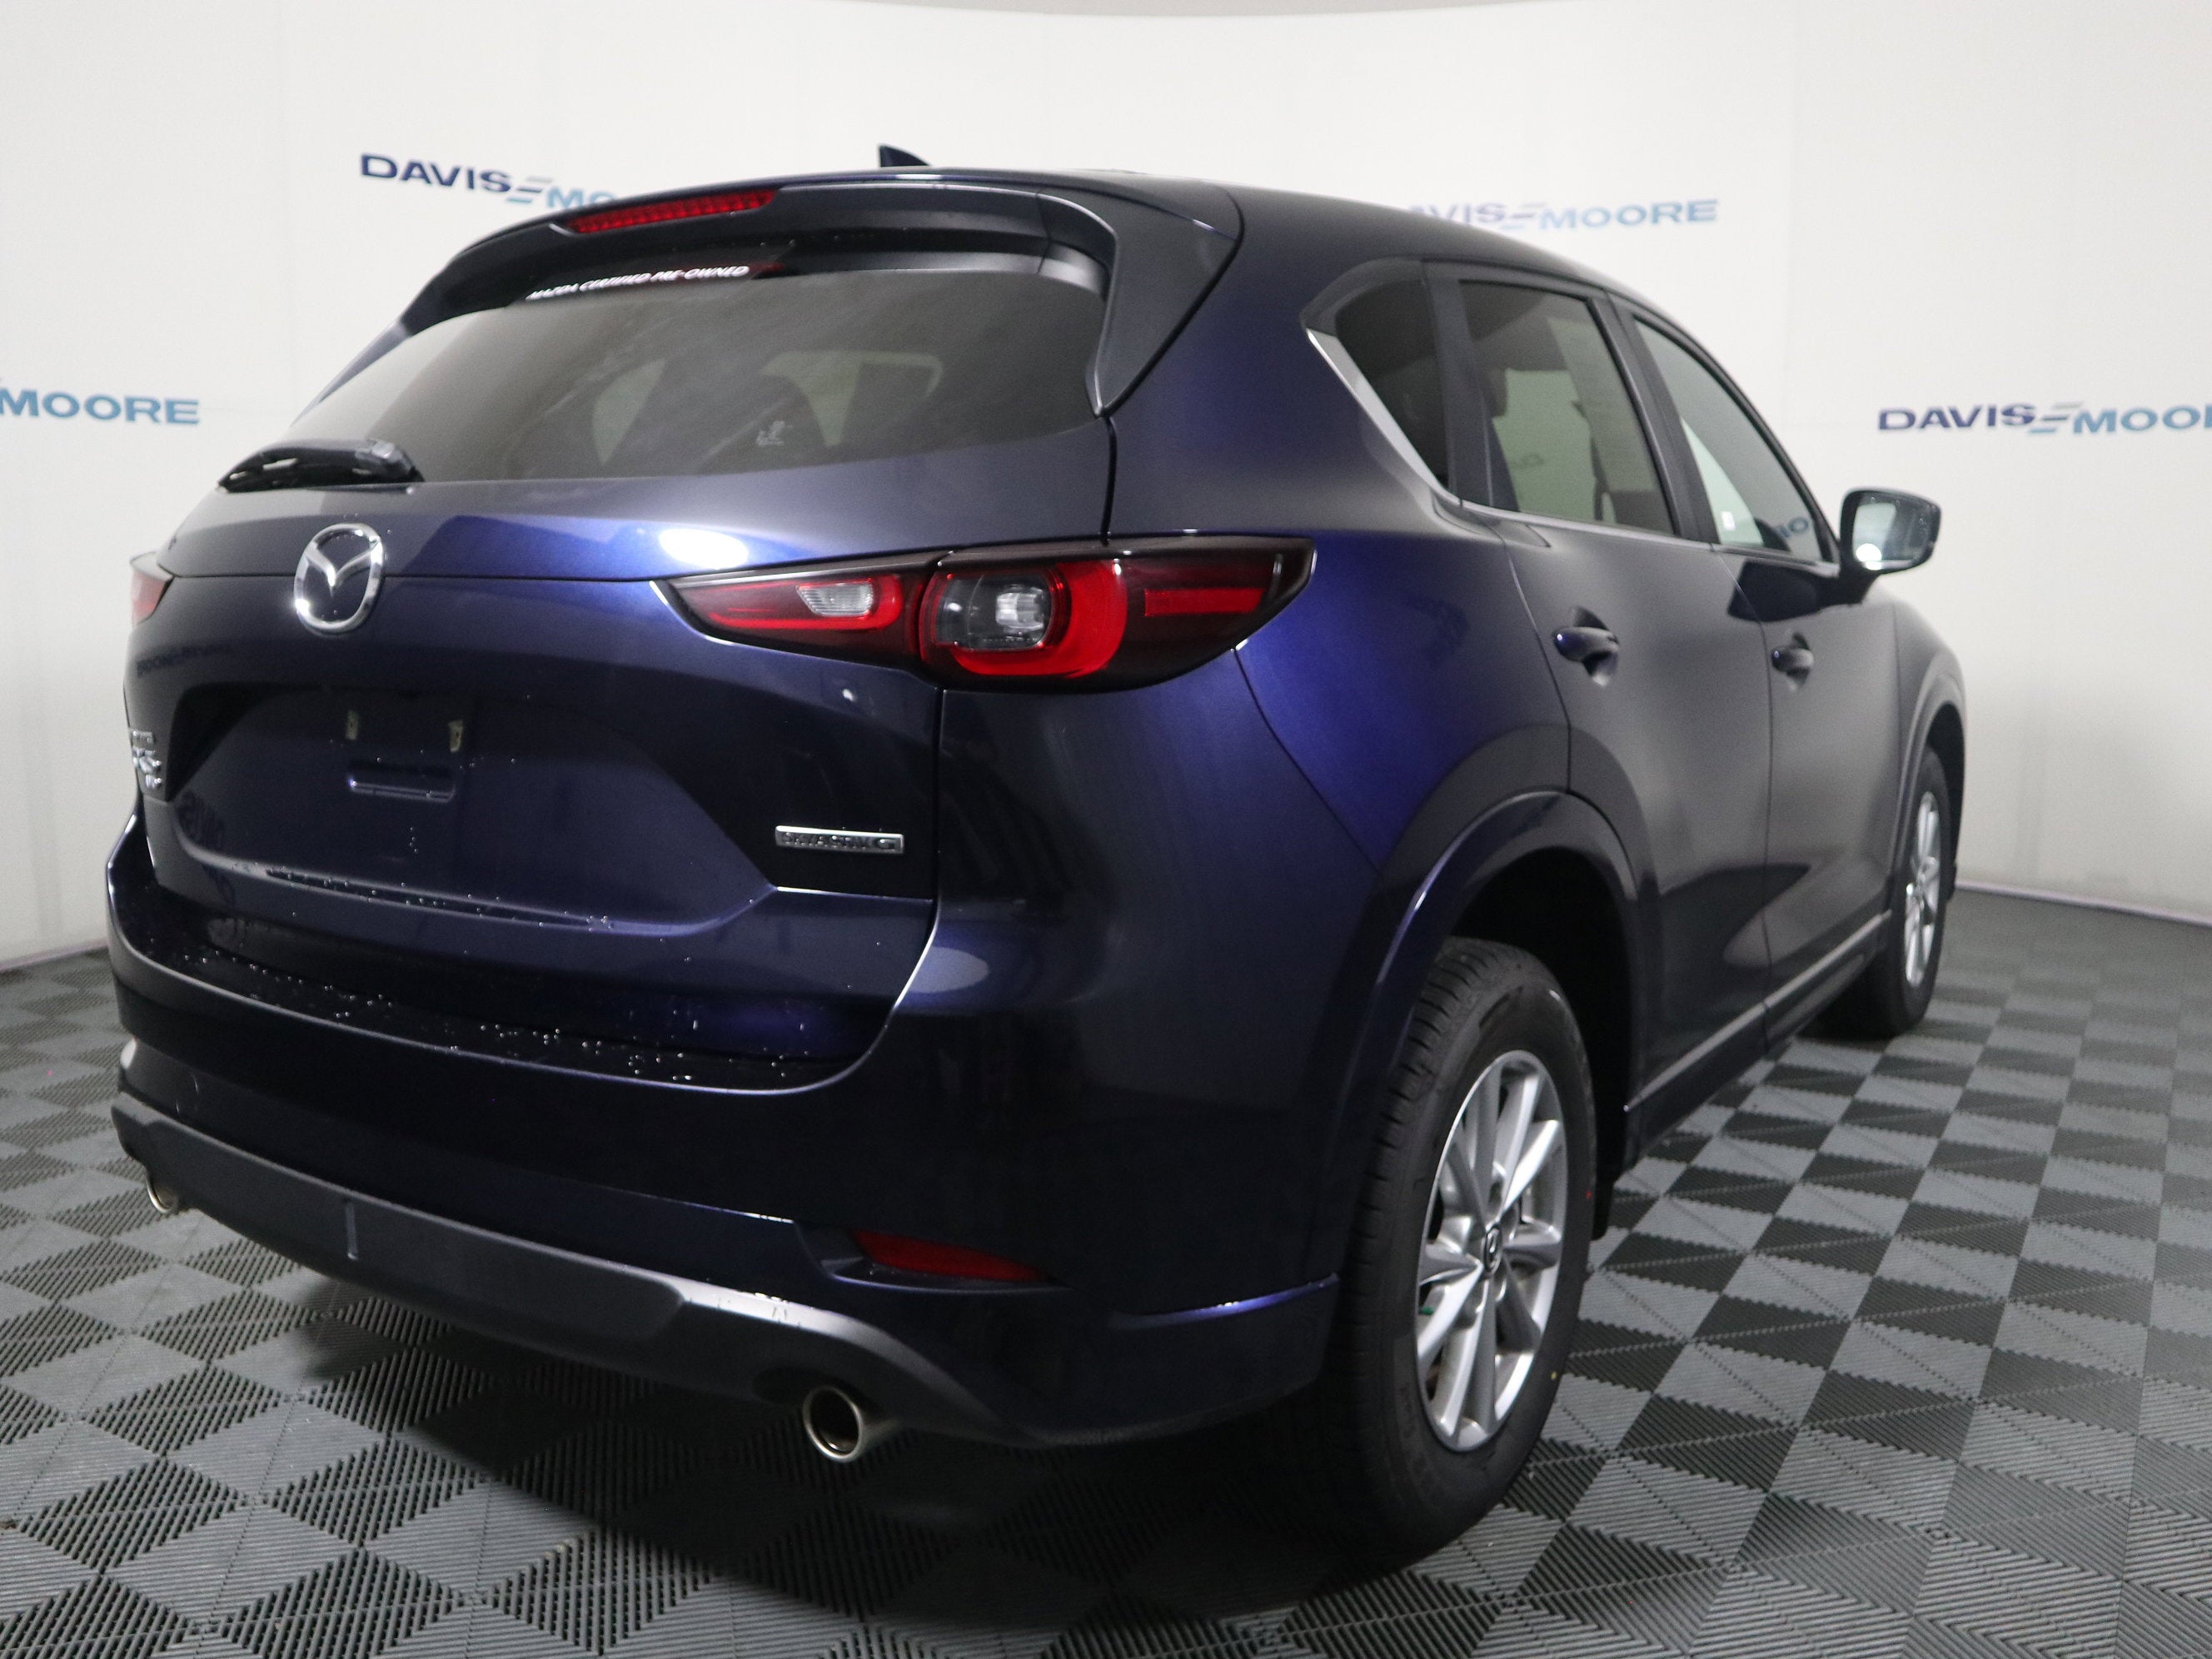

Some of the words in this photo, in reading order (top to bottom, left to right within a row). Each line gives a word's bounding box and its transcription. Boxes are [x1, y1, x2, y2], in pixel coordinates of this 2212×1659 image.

[361, 153, 512, 192] DAVIS
[1539, 198, 1718, 230] MOORE
[650, 266, 750, 282] PRE-OWNED
[0, 387, 200, 425] MOORE
[1879, 403, 2037, 431] DAVIS
[2074, 404, 2212, 434] MOO
